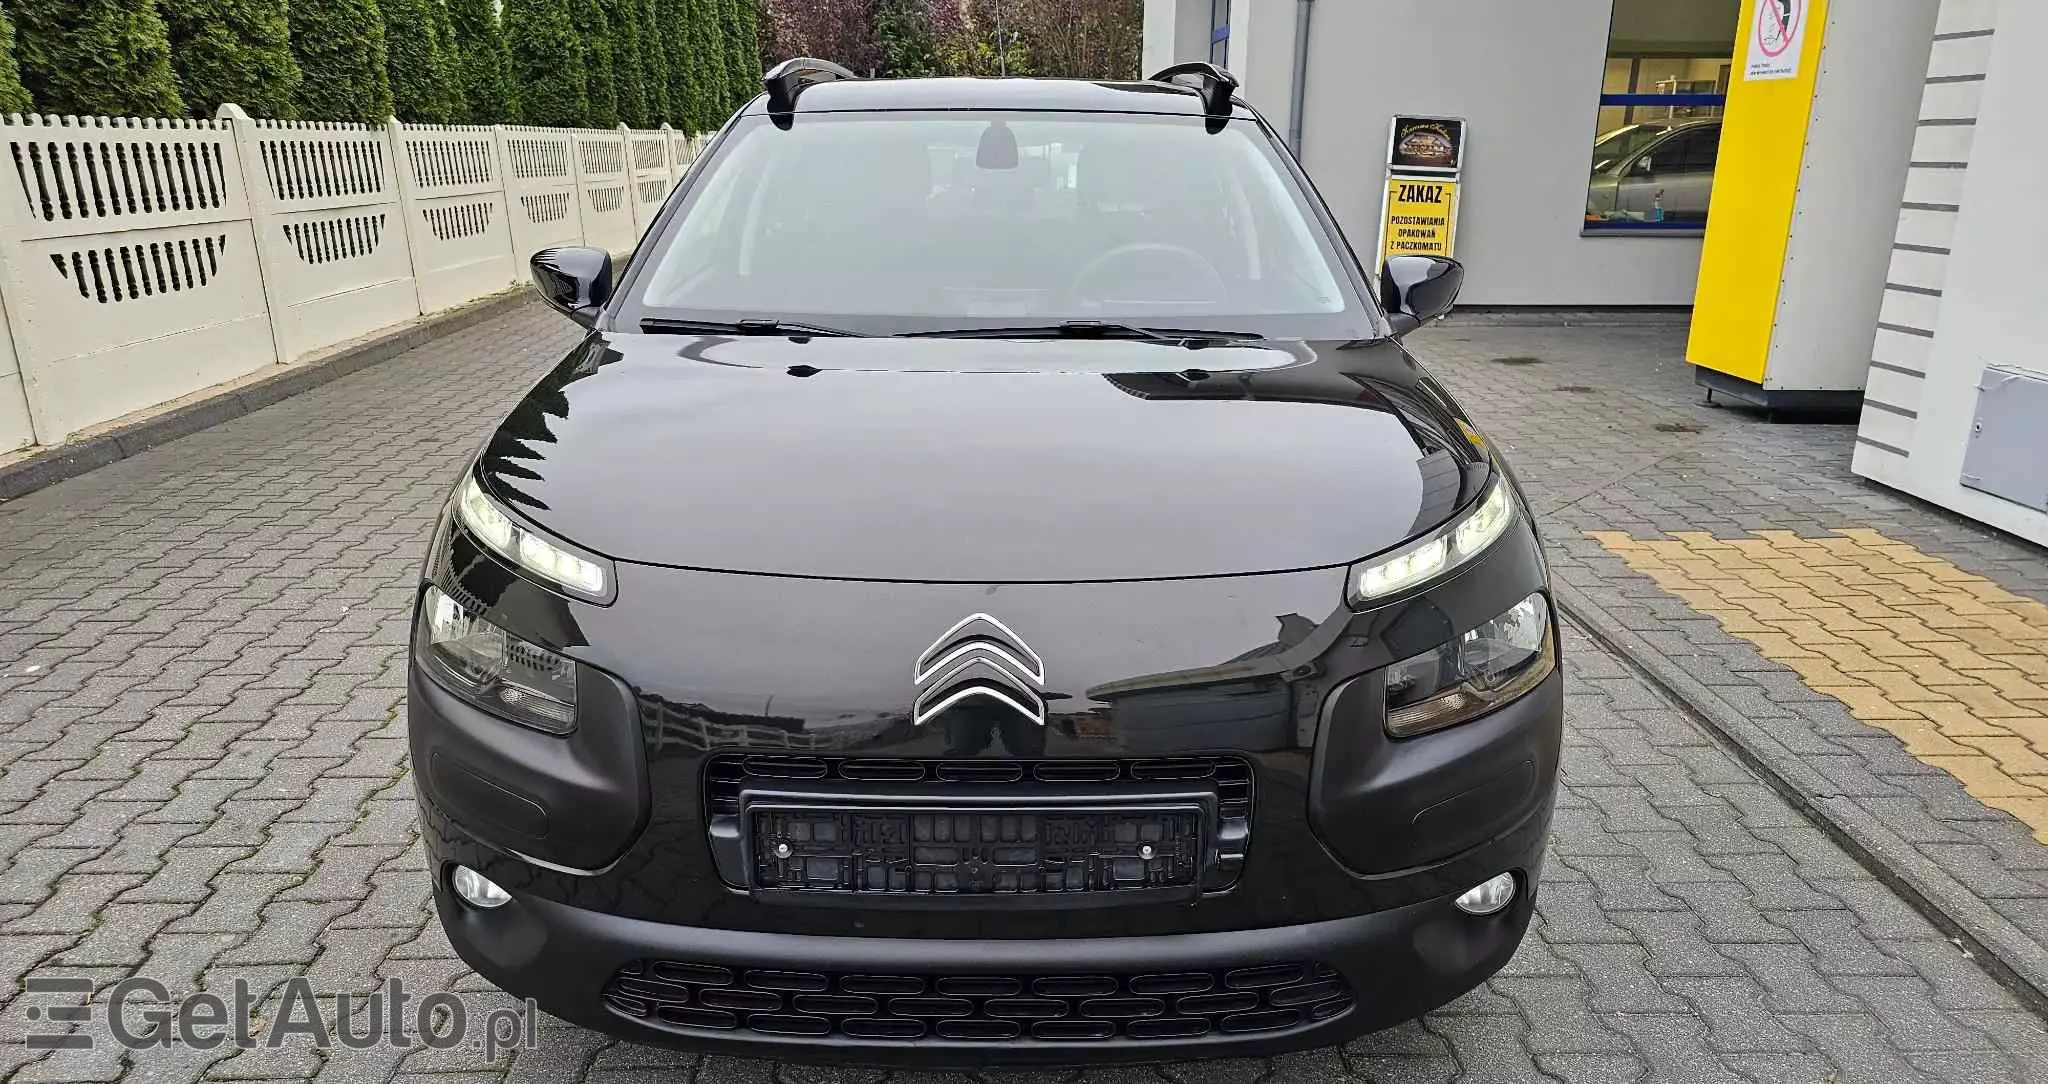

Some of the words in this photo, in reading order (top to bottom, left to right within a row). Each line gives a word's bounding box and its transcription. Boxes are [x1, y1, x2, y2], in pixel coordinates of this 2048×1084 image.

[1398, 184, 1443, 204] ZAKAZ
[1391, 215, 1445, 226] POZOSTAWIANIA
[1390, 241, 1395, 250] Z
[1396, 241, 1442, 251] PACZKOMATU
